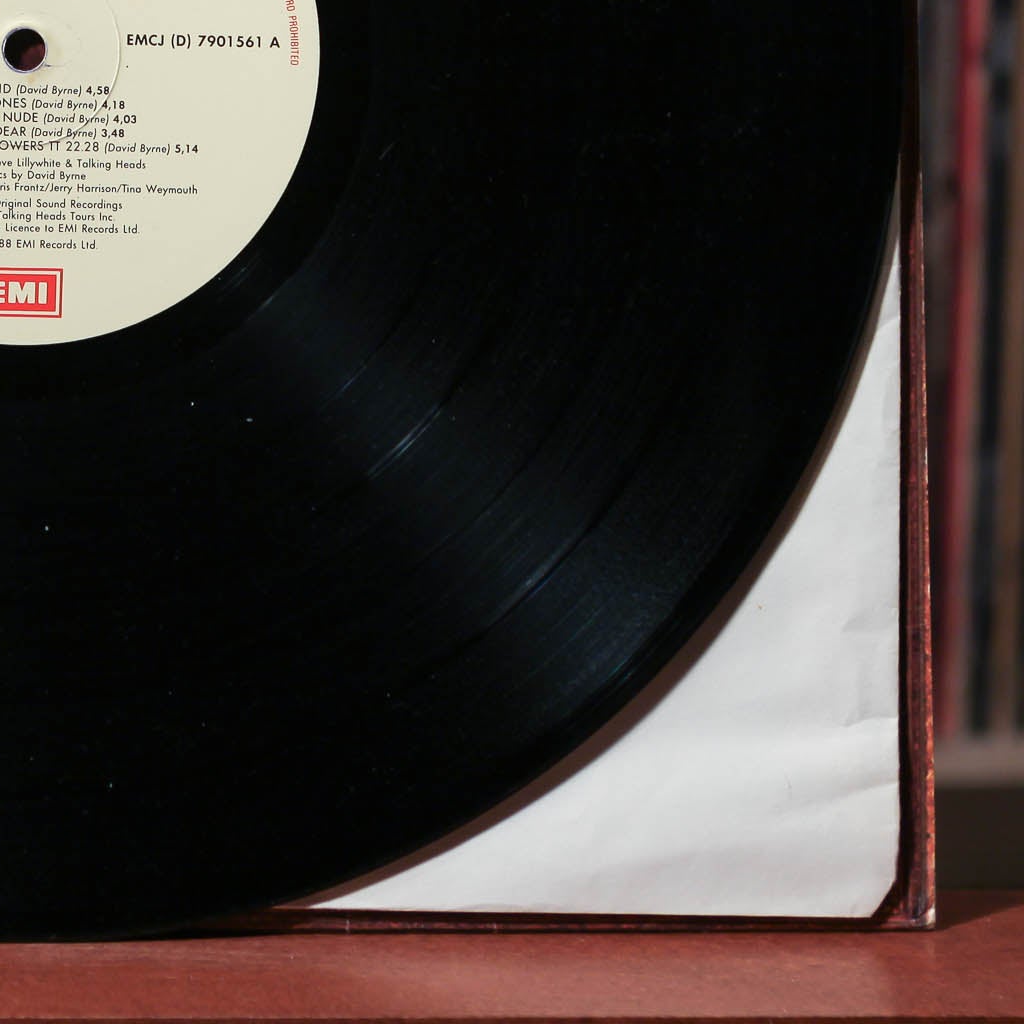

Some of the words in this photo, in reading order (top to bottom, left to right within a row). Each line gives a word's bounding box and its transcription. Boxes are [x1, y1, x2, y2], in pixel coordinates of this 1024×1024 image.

[126, 34, 164, 46] EMCJ
[171, 33, 192, 49] (D)
[198, 35, 261, 48] 7901561
[269, 36, 280, 49] A
[288, 15, 300, 66] PROHIBITED
[16, 83, 48, 96] (David
[51, 86, 82, 97] Byrne)
[86, 86, 110, 96] 4,58
[31, 98, 64, 111] (David
[67, 99, 98, 112] Byrne)
[101, 100, 126, 111] 4,18
[3, 112, 38, 123] NUDE
[43, 113, 75, 125] (David
[78, 114, 109, 126] Byrne)
[112, 114, 137, 125] 4,03
[31, 127, 63, 139] (David
[66, 128, 97, 139] Byrne)
[101, 128, 125, 139] 3,48
[65, 141, 100, 152] 22.28
[104, 142, 136, 155] (David
[139, 143, 171, 156] Byrne)
[174, 144, 199, 155] 5,14
[17, 157, 61, 170] Lillywhite
[65, 158, 73, 168] &
[76, 158, 112, 171] Talking
[115, 159, 146, 170] Heads
[11, 169, 23, 182] by
[27, 170, 55, 180] David
[59, 171, 86, 183] Byrne
[14, 182, 73, 194] Frantz/Jerry
[77, 183, 142, 194] Harrison/Tina
[146, 184, 198, 196] Weymouth
[36, 198, 66, 209] Sound
[70, 199, 123, 212] Recordings
[36, 210, 66, 221] Heads
[70, 211, 95, 221] Tours
[5, 222, 40, 233] Licence
[44, 224, 54, 233] to
[58, 223, 77, 233] EMI
[81, 224, 119, 234] Records
[123, 224, 140, 234] Ltd.
[16, 239, 36, 249] EMI
[40, 239, 77, 249] Records
[81, 240, 98, 250] Ltd.
